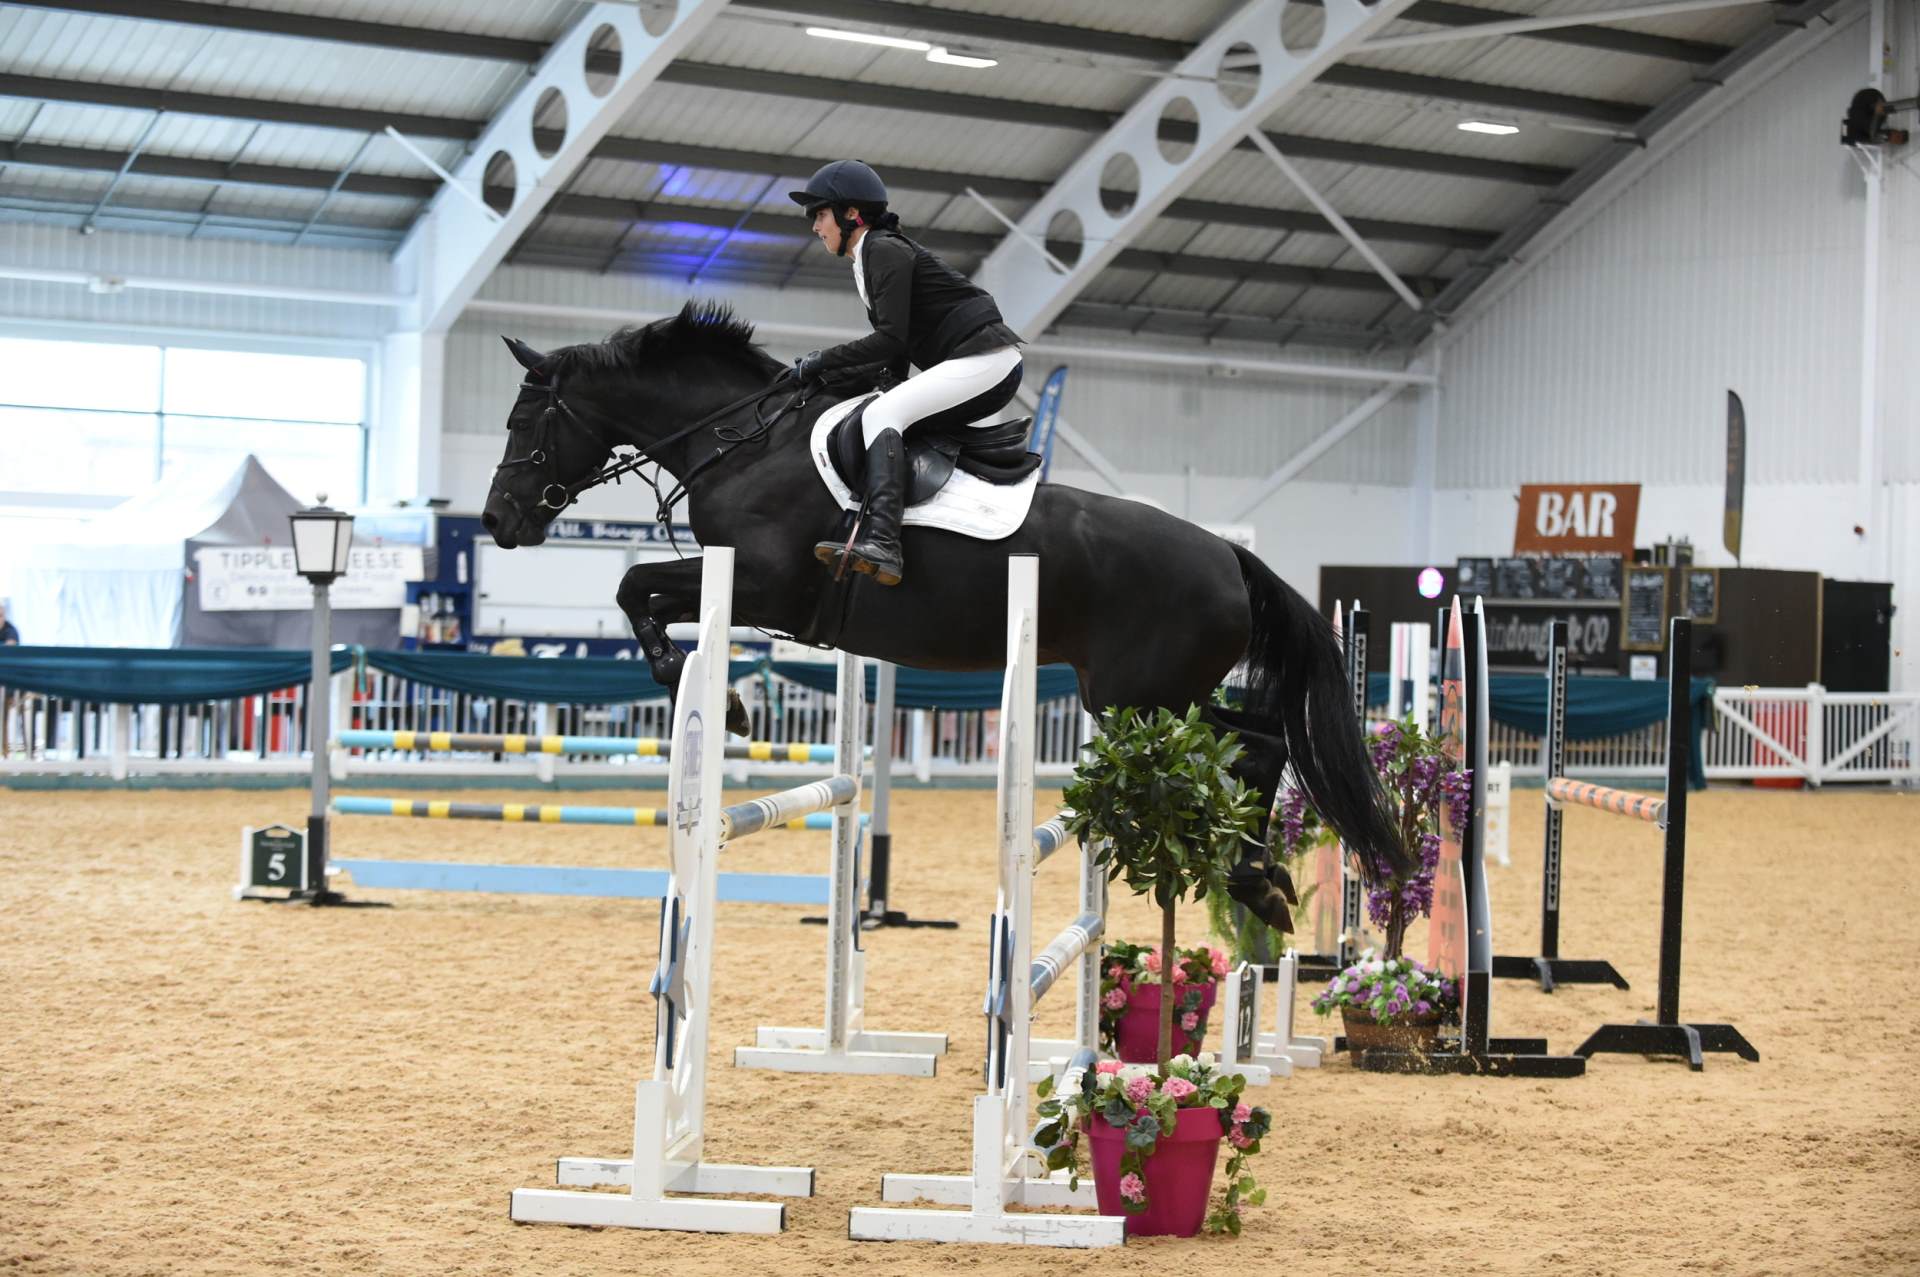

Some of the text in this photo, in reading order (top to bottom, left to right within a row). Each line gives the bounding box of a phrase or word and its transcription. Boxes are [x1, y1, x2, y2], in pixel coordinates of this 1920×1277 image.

[1535, 491, 1617, 538] BAR
[549, 521, 584, 538] All
[220, 552, 404, 570] TIPPLE EESE
[267, 853, 286, 881] 5
[1238, 1006, 1251, 1047] 12
